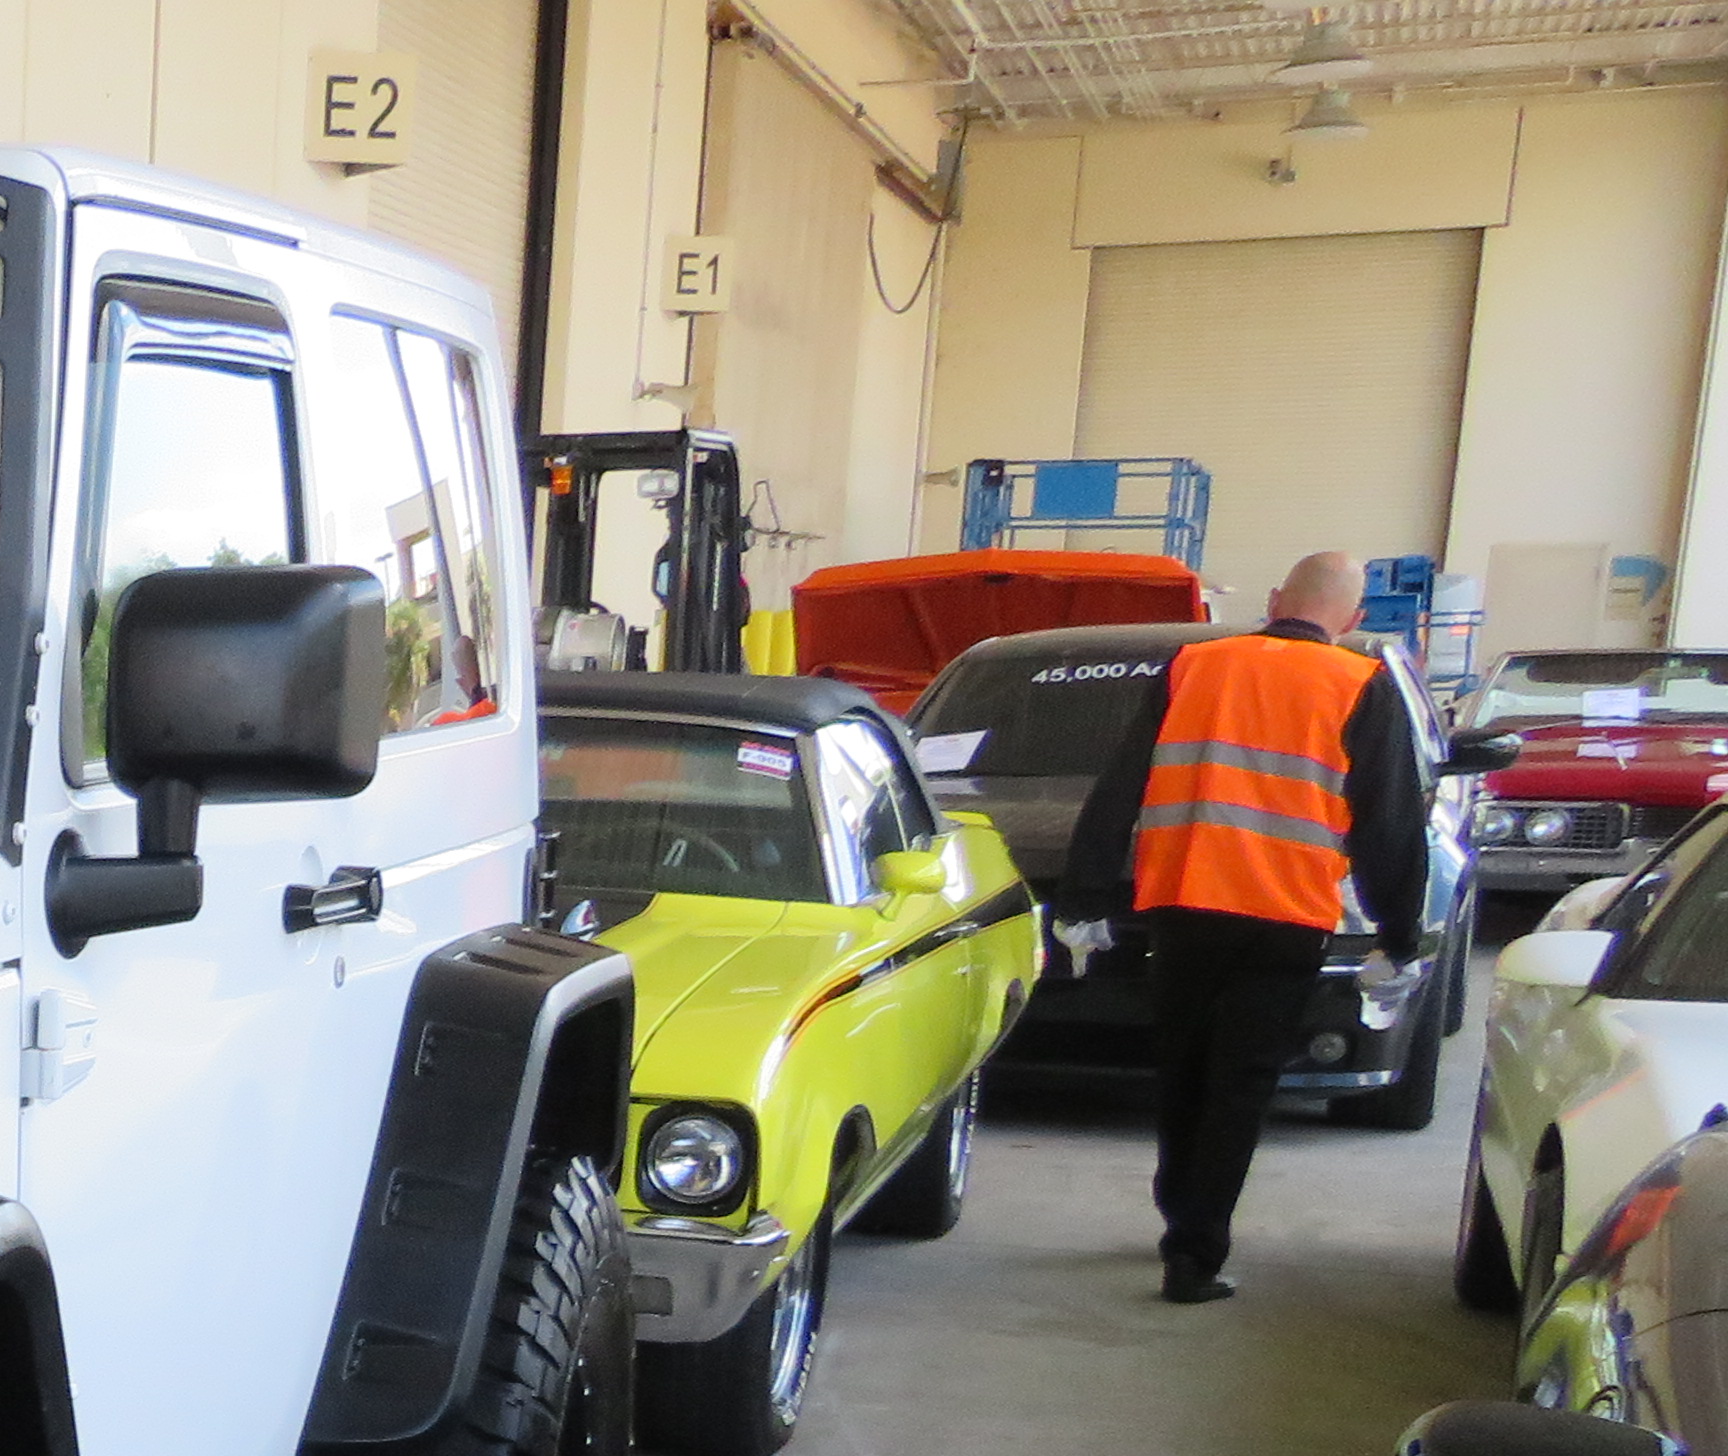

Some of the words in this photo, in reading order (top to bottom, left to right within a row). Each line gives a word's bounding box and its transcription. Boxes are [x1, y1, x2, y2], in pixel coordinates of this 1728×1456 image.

[322, 74, 399, 140] E2
[675, 252, 721, 296] E1
[1031, 663, 1127, 684] 45,000
